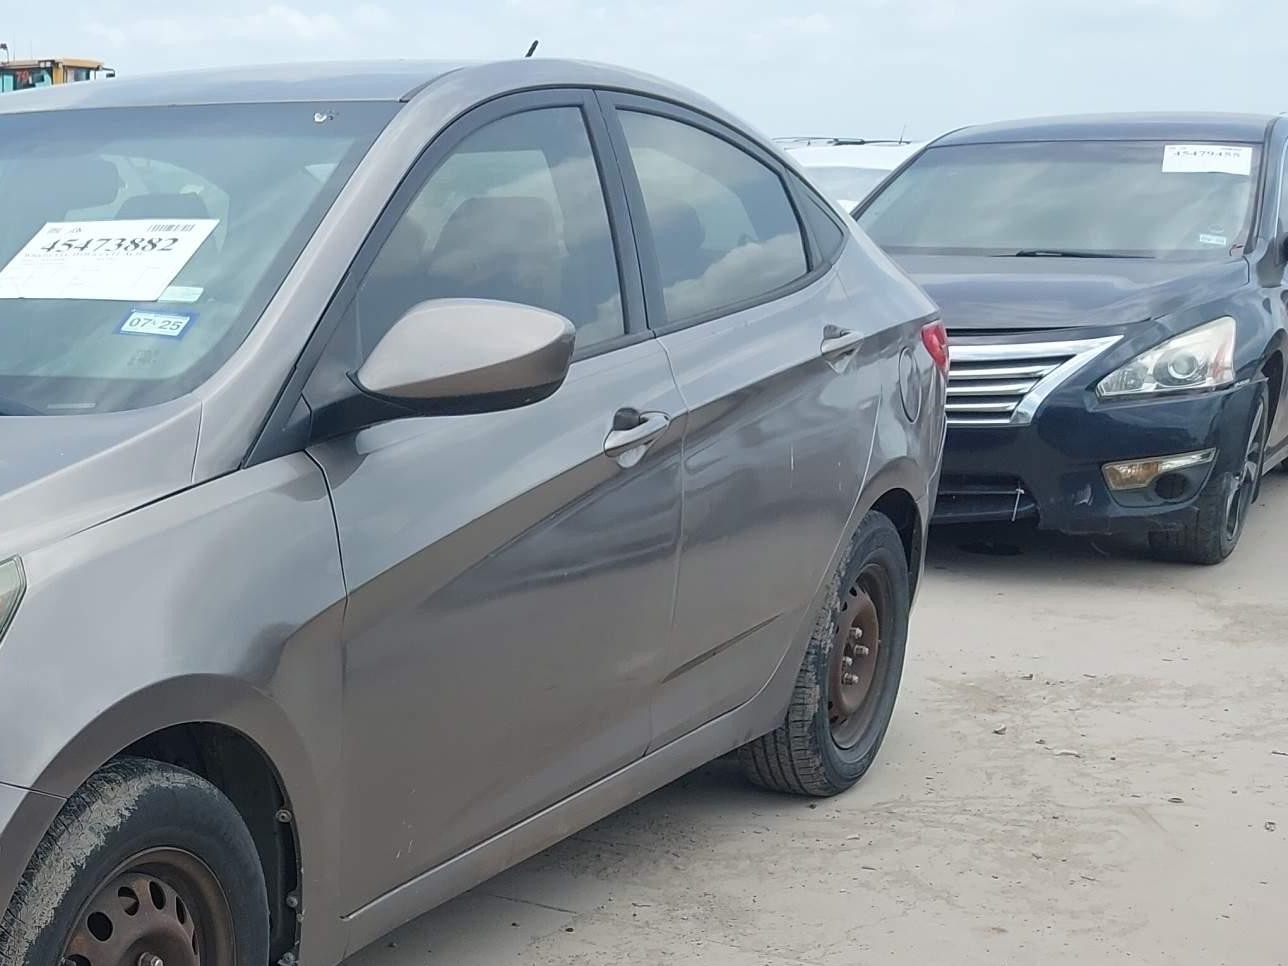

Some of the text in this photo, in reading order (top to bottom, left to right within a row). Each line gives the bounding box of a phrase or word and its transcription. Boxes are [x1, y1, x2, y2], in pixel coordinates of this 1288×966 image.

[40, 237, 179, 253] 45473882
[128, 318, 184, 331] 07 25
